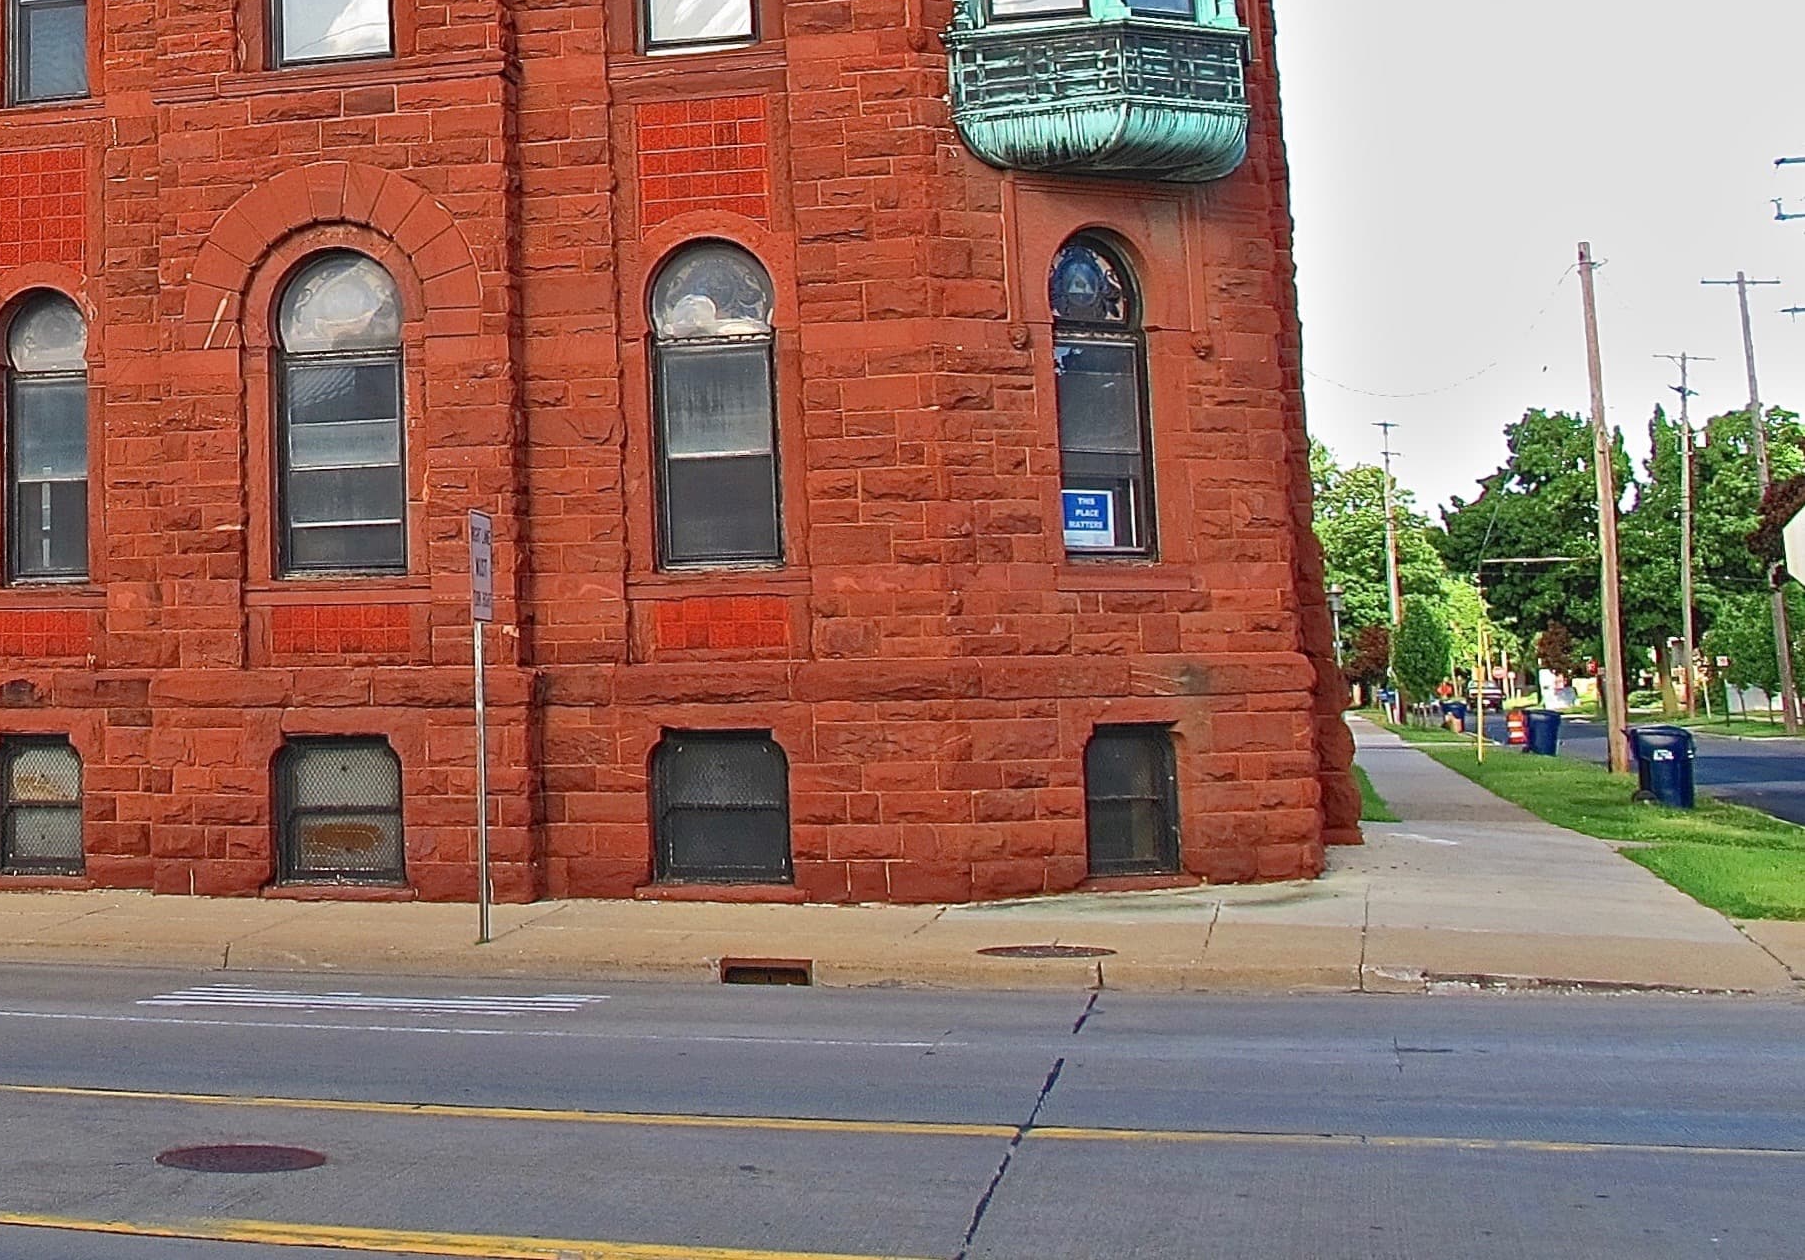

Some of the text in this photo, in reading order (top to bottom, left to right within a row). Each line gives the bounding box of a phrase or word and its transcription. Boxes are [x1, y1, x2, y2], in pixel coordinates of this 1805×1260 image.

[1077, 497, 1095, 506] THIS
[1075, 509, 1099, 517] PLACE
[1069, 520, 1102, 529] MATTERS
